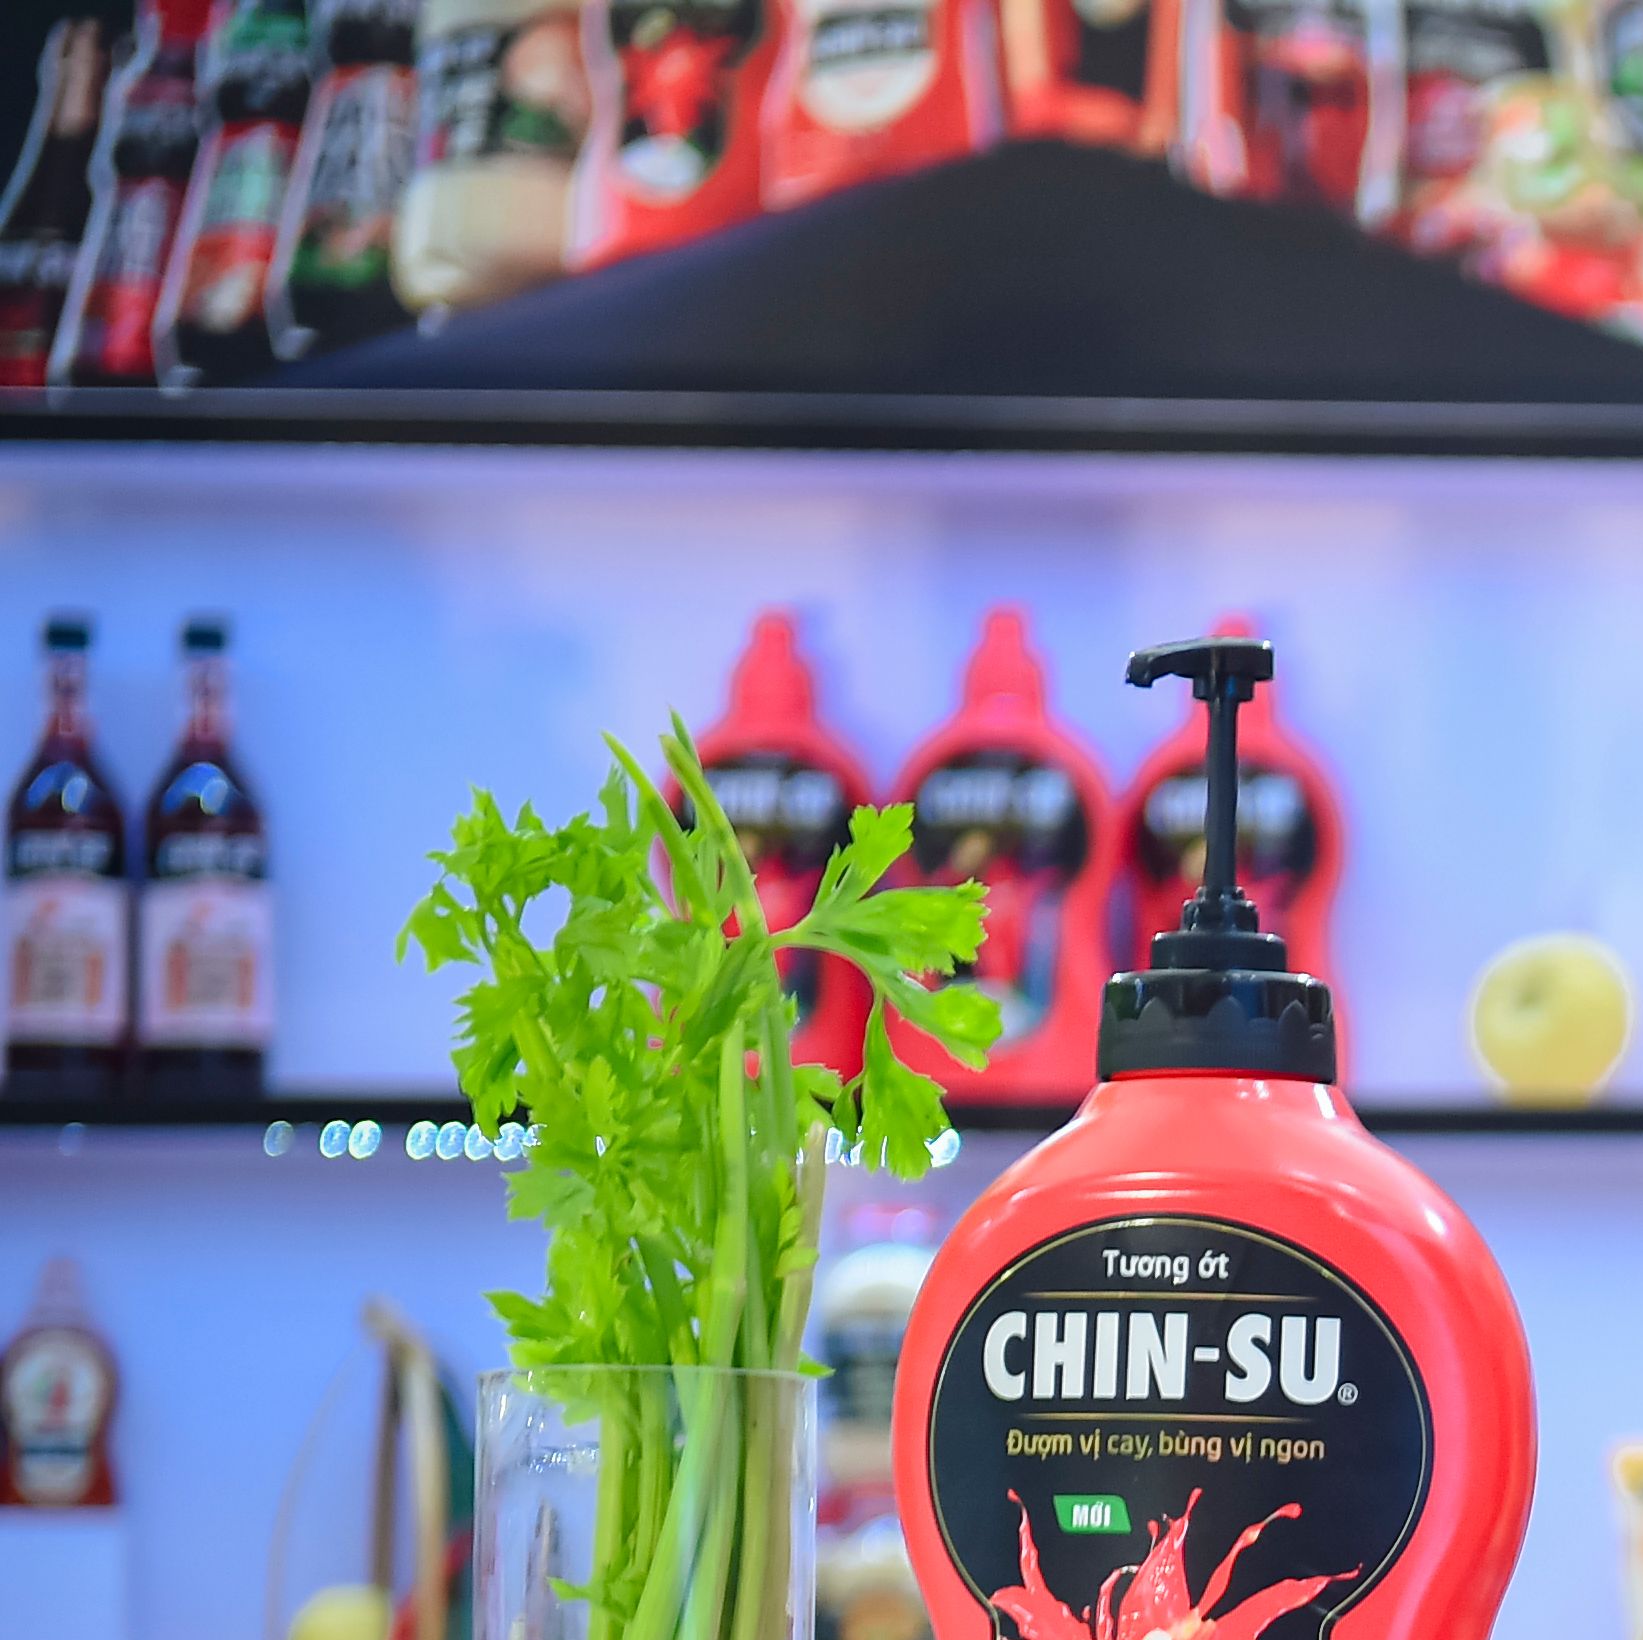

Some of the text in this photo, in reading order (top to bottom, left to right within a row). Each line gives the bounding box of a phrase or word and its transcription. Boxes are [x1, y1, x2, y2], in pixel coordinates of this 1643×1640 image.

[1102, 1249, 1231, 1286] Tương ớt
[983, 1310, 1342, 1407] CHIN-SU
[1006, 1428, 1326, 1465] Đượm vị cay, bùng vị ngon
[1072, 1500, 1112, 1529] MỚI
